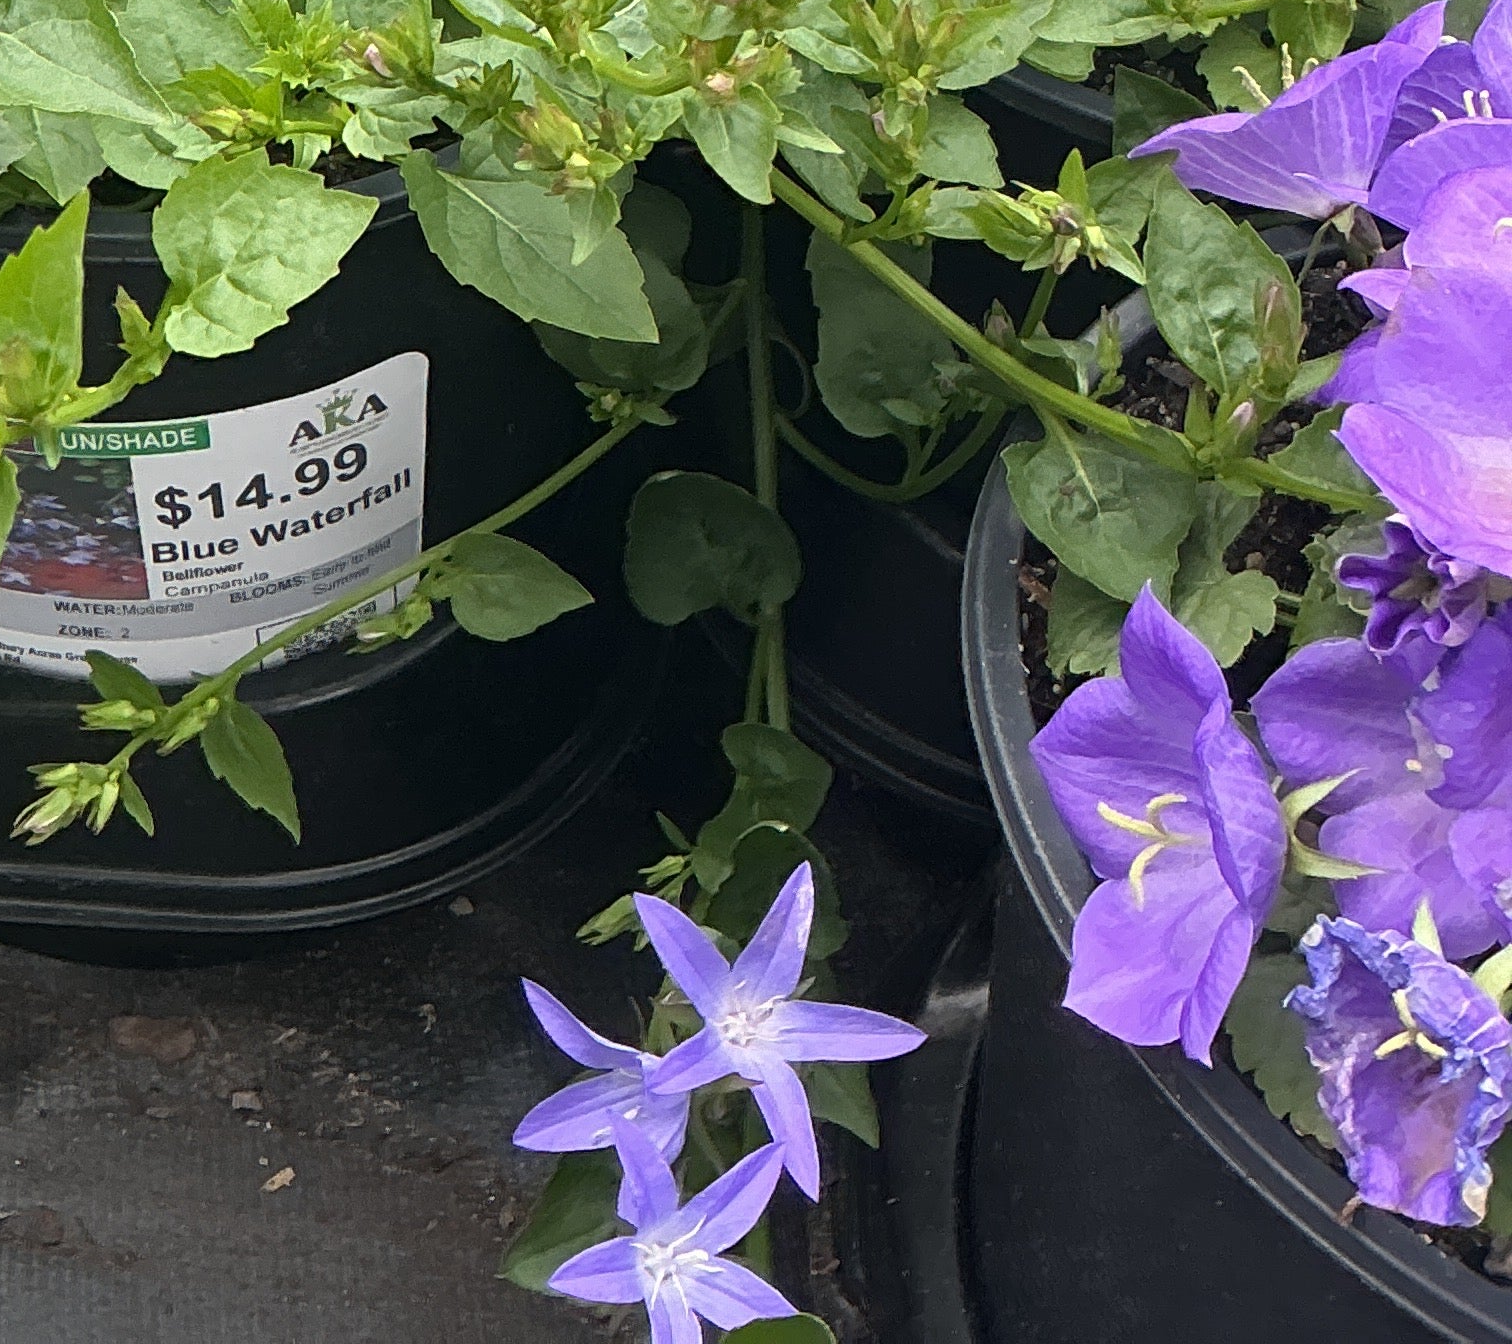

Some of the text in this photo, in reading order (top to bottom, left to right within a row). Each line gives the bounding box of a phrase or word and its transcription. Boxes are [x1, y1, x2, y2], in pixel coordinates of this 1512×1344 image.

[59, 427, 198, 451] UN/SHADE
[289, 390, 388, 447] AKA
[154, 443, 368, 529] $14.99
[152, 468, 411, 564] Blue Waterfall
[163, 562, 245, 583] Bellflower
[165, 571, 270, 598] Campanula
